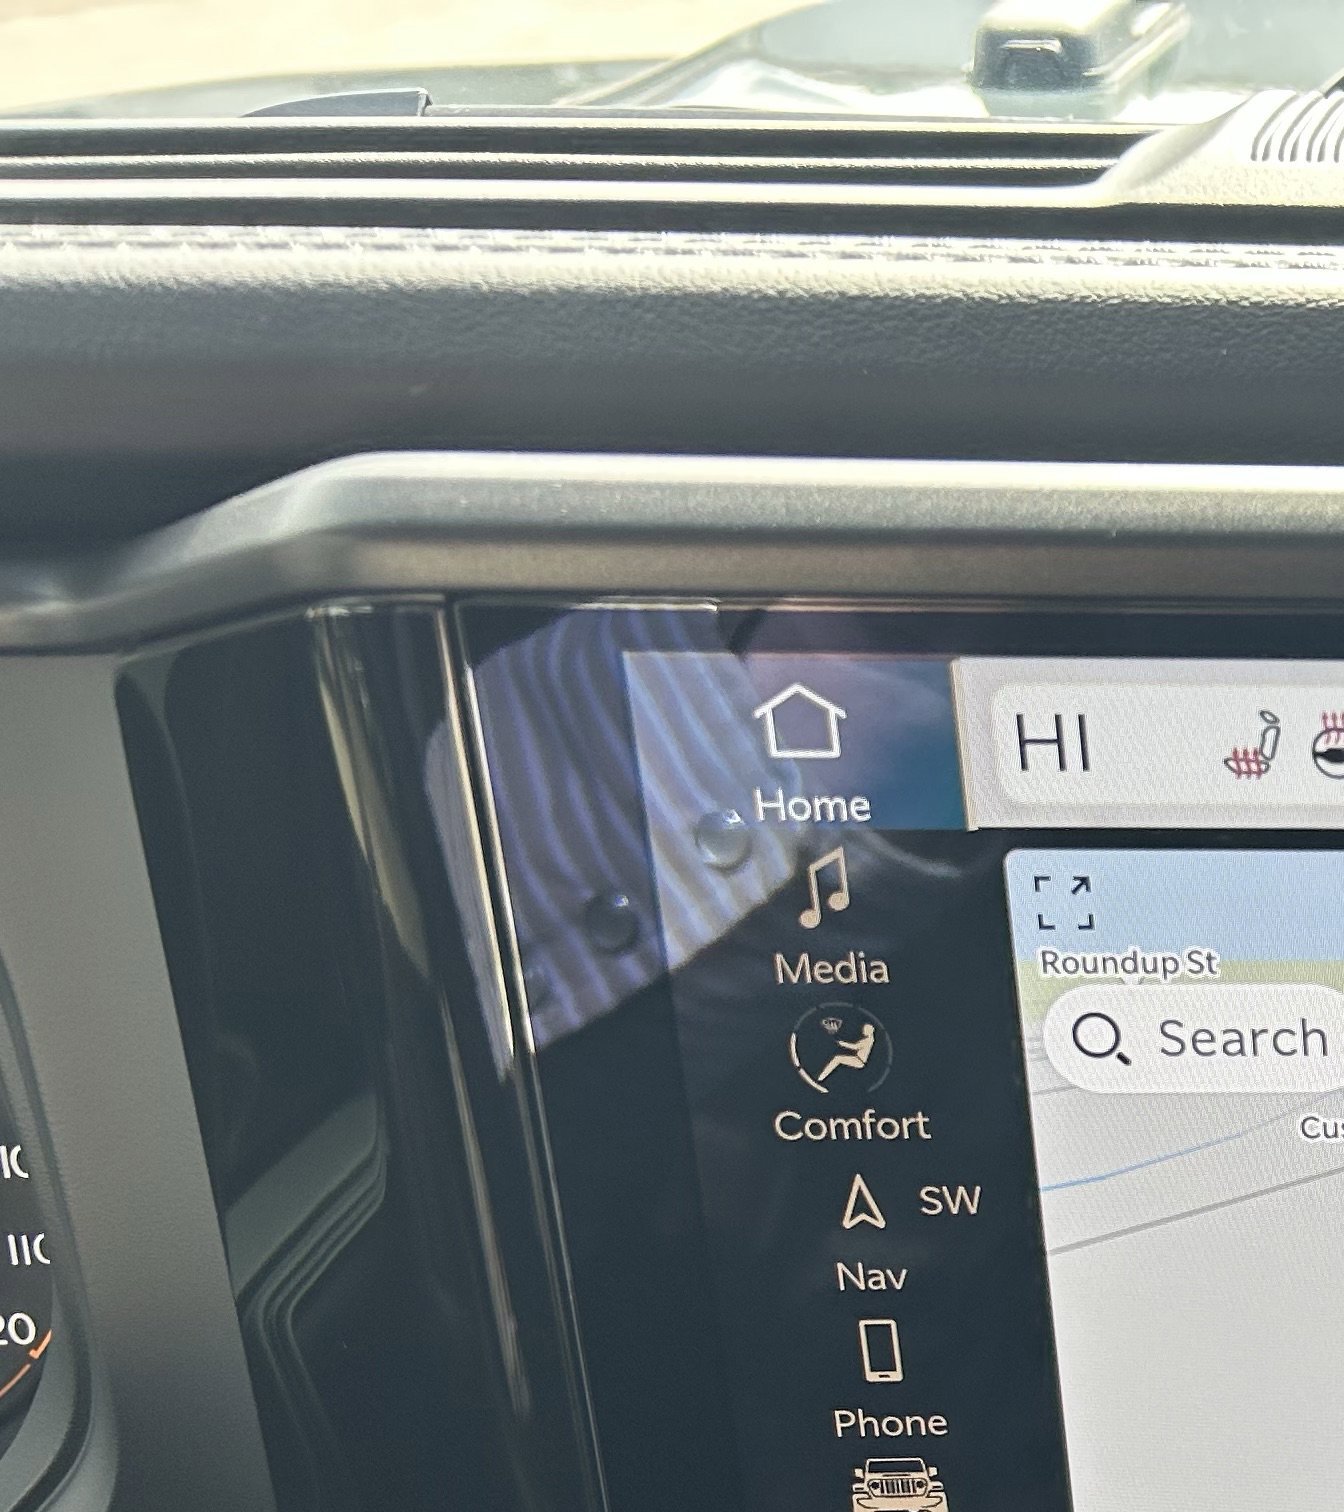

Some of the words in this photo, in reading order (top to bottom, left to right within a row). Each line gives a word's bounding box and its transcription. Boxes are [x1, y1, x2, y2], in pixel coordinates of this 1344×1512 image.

[1015, 713, 1091, 772] HI
[754, 789, 871, 823] Home
[774, 953, 889, 984] Media
[1041, 951, 1180, 979] Roundup
[1186, 951, 1218, 976] St
[1159, 1018, 1329, 1058] Search
[775, 1110, 930, 1140] Comfort
[920, 1186, 981, 1216] SW
[836, 1262, 907, 1291] Nav
[834, 1409, 948, 1438] Phone
